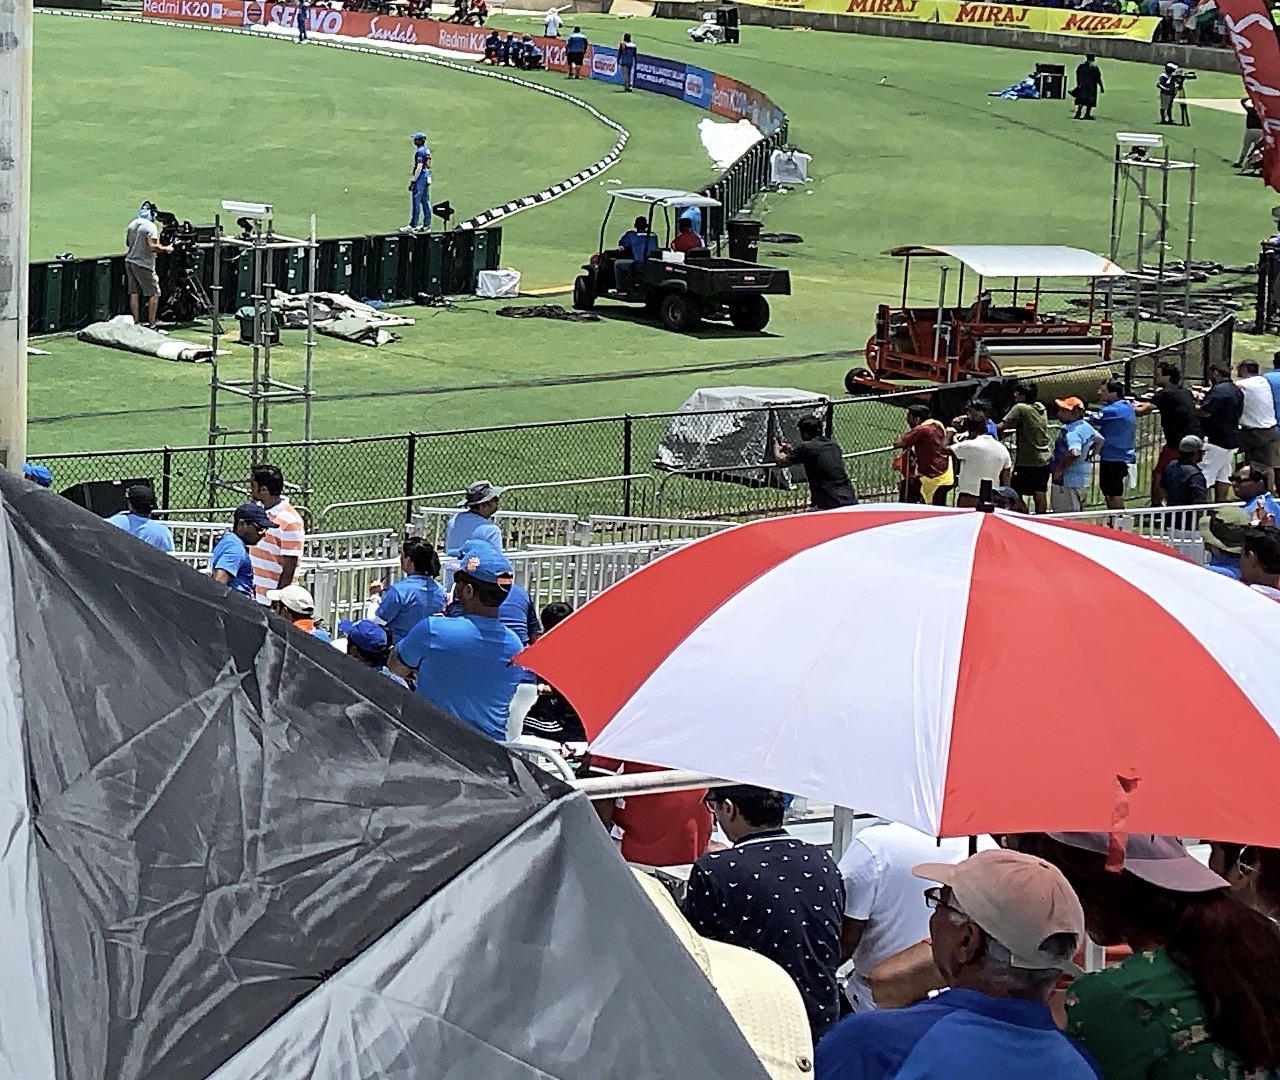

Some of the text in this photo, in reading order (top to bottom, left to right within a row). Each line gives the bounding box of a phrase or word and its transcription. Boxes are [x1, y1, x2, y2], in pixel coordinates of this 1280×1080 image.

[144, 0, 180, 15] Redmi
[181, 1, 210, 18] K20
[955, 3, 1029, 23] MIRAJ
[367, 16, 417, 44] Sandals
[1060, 14, 1138, 32] MIRAJ
[440, 29, 469, 47] Redmi
